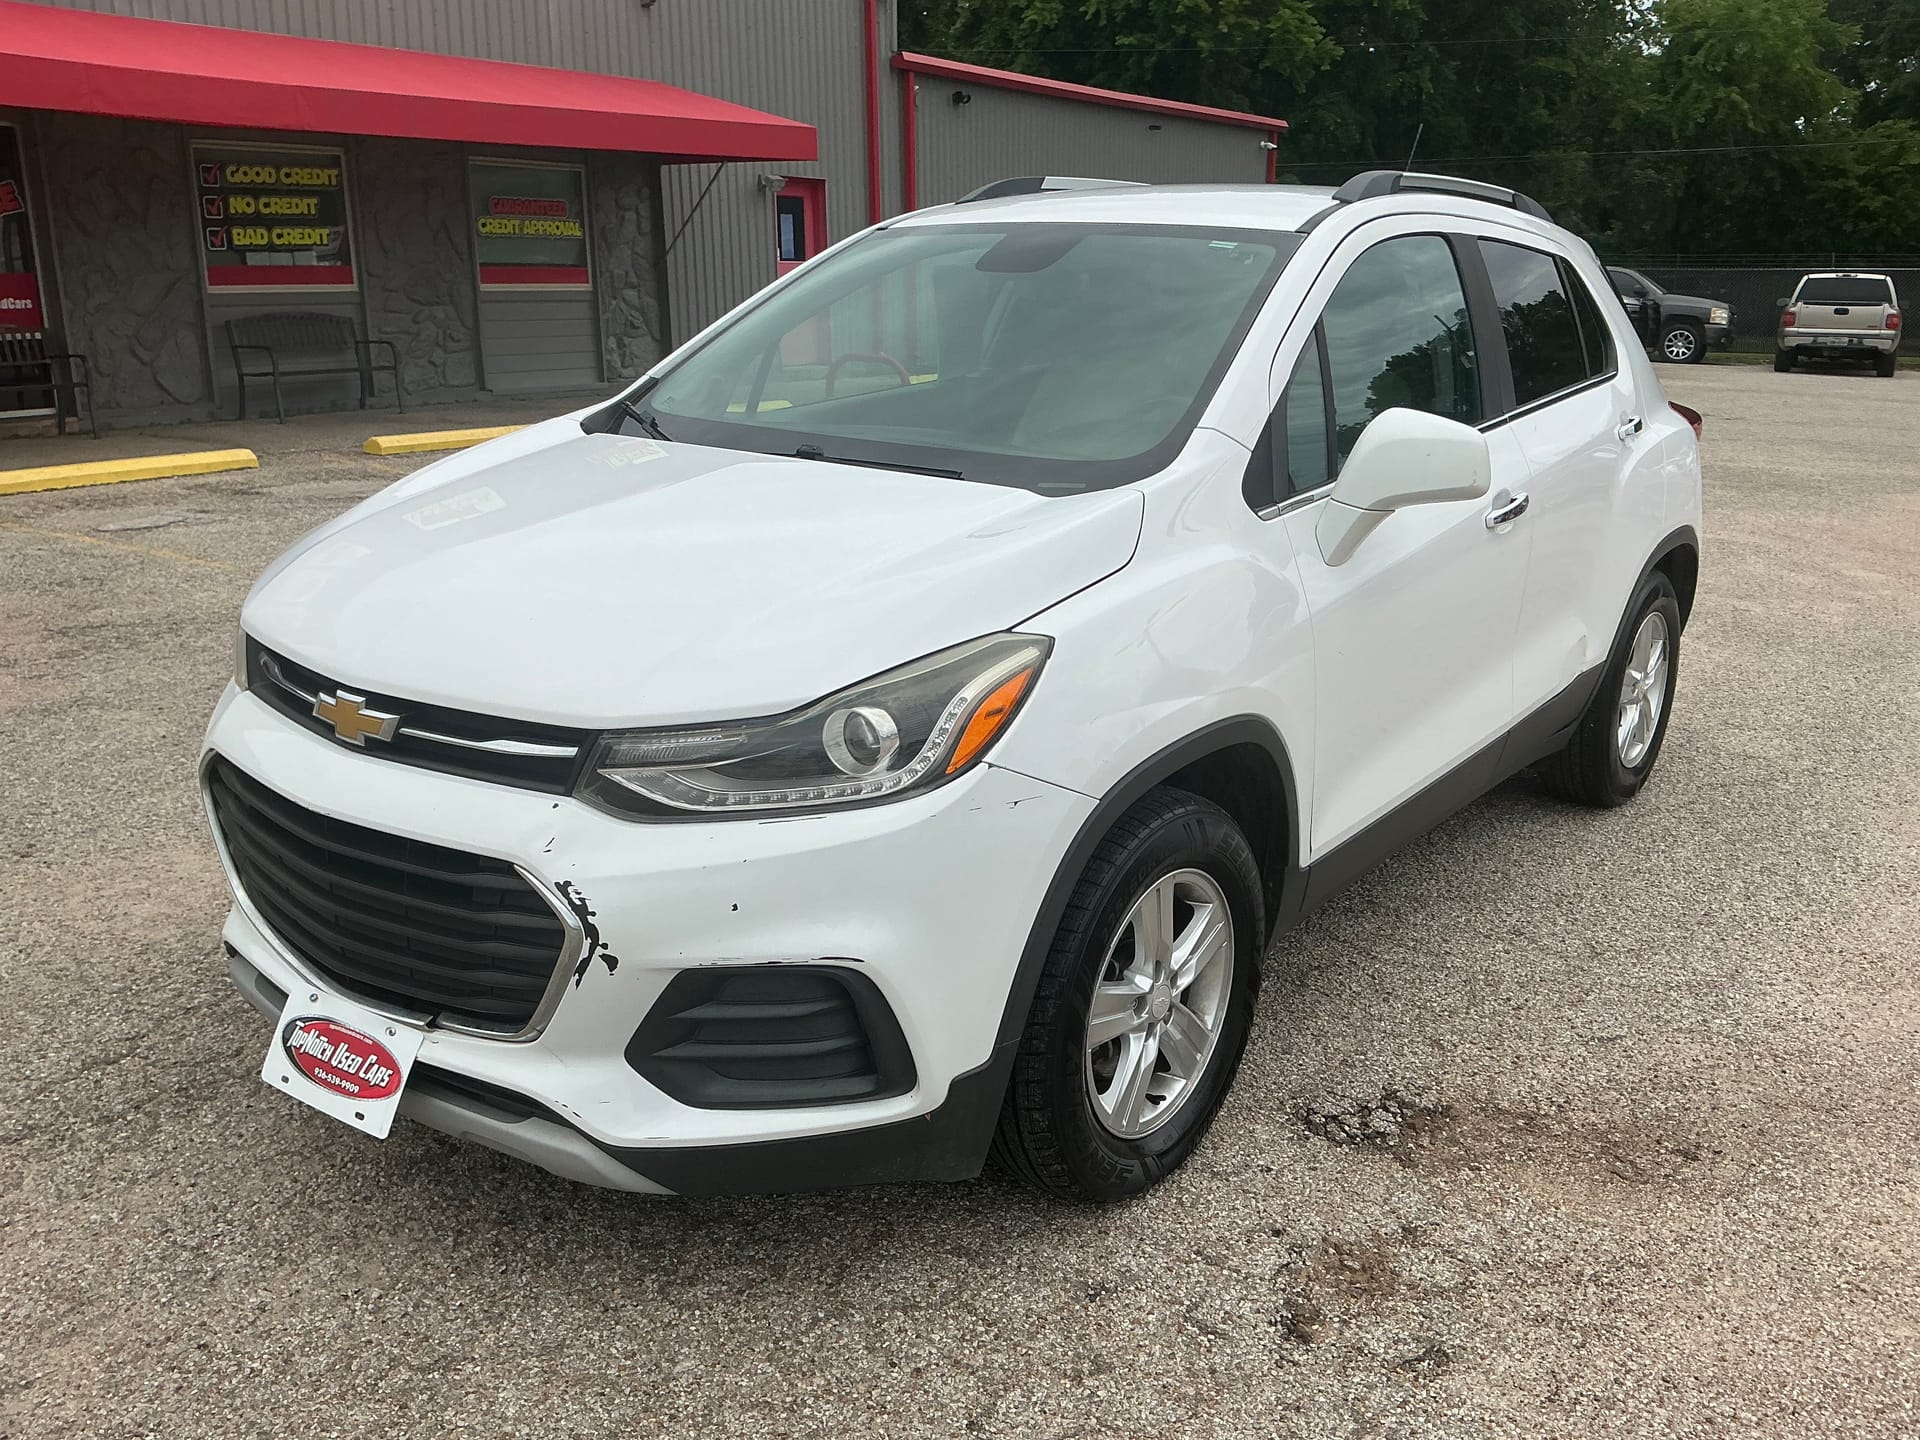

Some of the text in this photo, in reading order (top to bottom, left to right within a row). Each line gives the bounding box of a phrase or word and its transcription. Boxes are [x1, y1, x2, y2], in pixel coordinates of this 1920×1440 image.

[226, 165, 339, 186] GOOD CREDIT
[229, 196, 319, 216] NO CREDIT
[490, 197, 568, 217] GUARANTEED
[232, 227, 331, 246] BAD CREDIT
[478, 217, 583, 237] CREDIT APPROVAL
[0, 297, 33, 309] dCars
[313, 1066, 360, 1094] 936-539-9909
